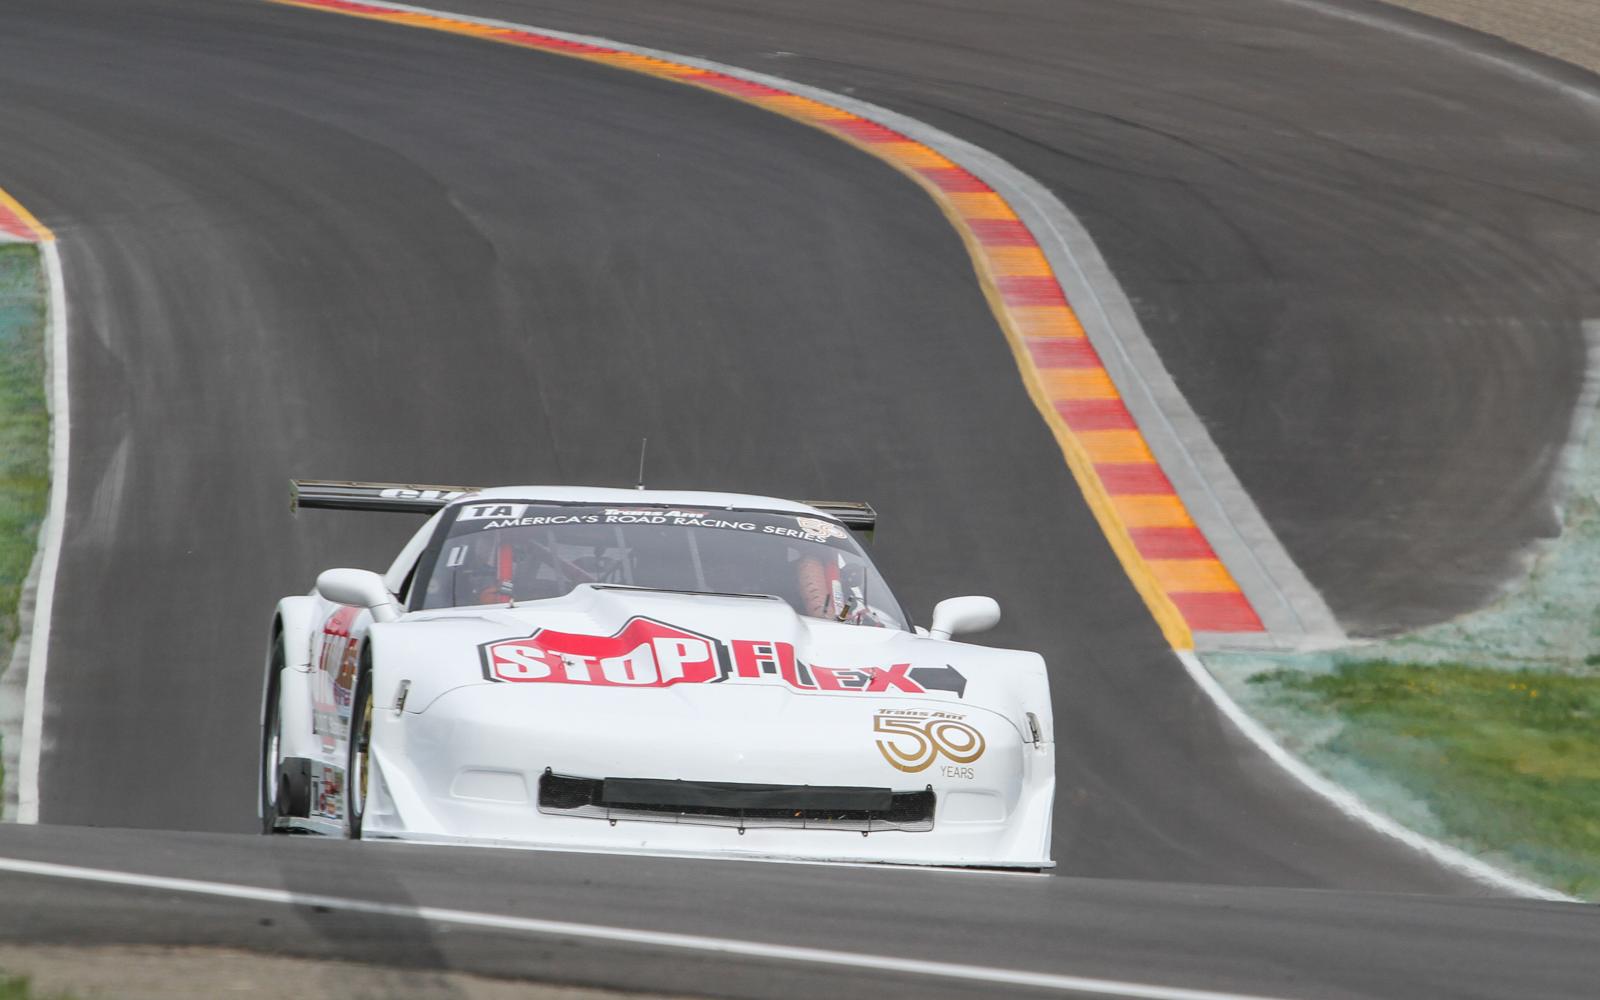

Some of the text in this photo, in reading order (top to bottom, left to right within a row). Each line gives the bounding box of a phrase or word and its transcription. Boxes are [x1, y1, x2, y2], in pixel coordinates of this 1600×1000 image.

[472, 506, 513, 517] TA
[604, 509, 704, 519] Trans Am
[482, 515, 827, 543] AMERICA'S ROAD RACING SERIES
[878, 708, 967, 721] Trans Am
[873, 714, 986, 774] 50
[940, 765, 975, 780] YEARS
